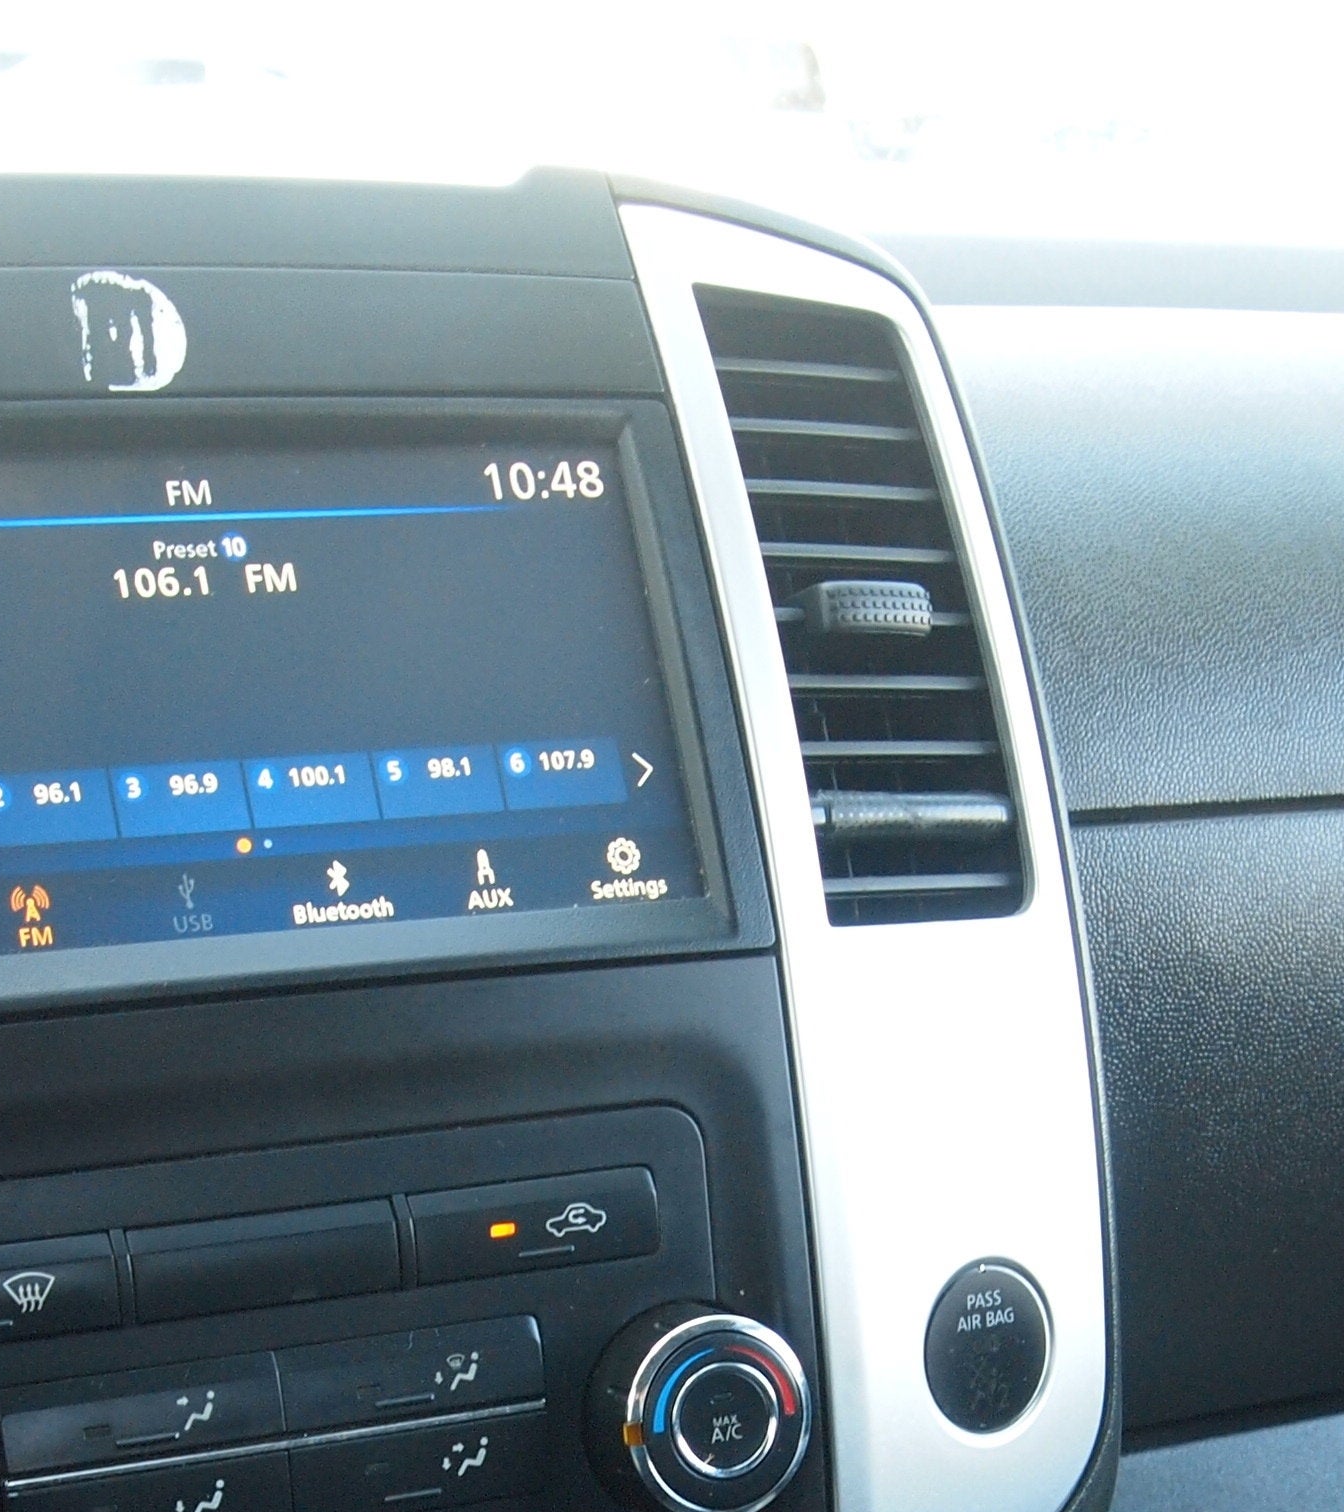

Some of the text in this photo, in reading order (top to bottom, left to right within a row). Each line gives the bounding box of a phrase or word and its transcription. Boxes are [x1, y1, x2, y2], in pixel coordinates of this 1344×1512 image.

[165, 479, 213, 507] FM
[482, 460, 605, 501] 10:48
[152, 536, 247, 561] Preset 10
[113, 562, 298, 599] 106.1 FM
[385, 755, 473, 782] 5 98.1
[509, 748, 596, 774] 6 107.9
[125, 772, 219, 799] 3 96.9
[257, 763, 347, 790] 4 100.1
[33, 780, 82, 806] 96.1
[467, 886, 514, 912] AUX
[590, 875, 668, 902] Settings
[173, 912, 214, 935] USB
[292, 896, 395, 927] Bluetooth
[18, 926, 54, 949] FM
[966, 1289, 1002, 1311] PASS
[957, 1306, 1015, 1333] AIR BAG
[711, 1422, 744, 1445] A/C
[712, 1413, 739, 1428] MAX
